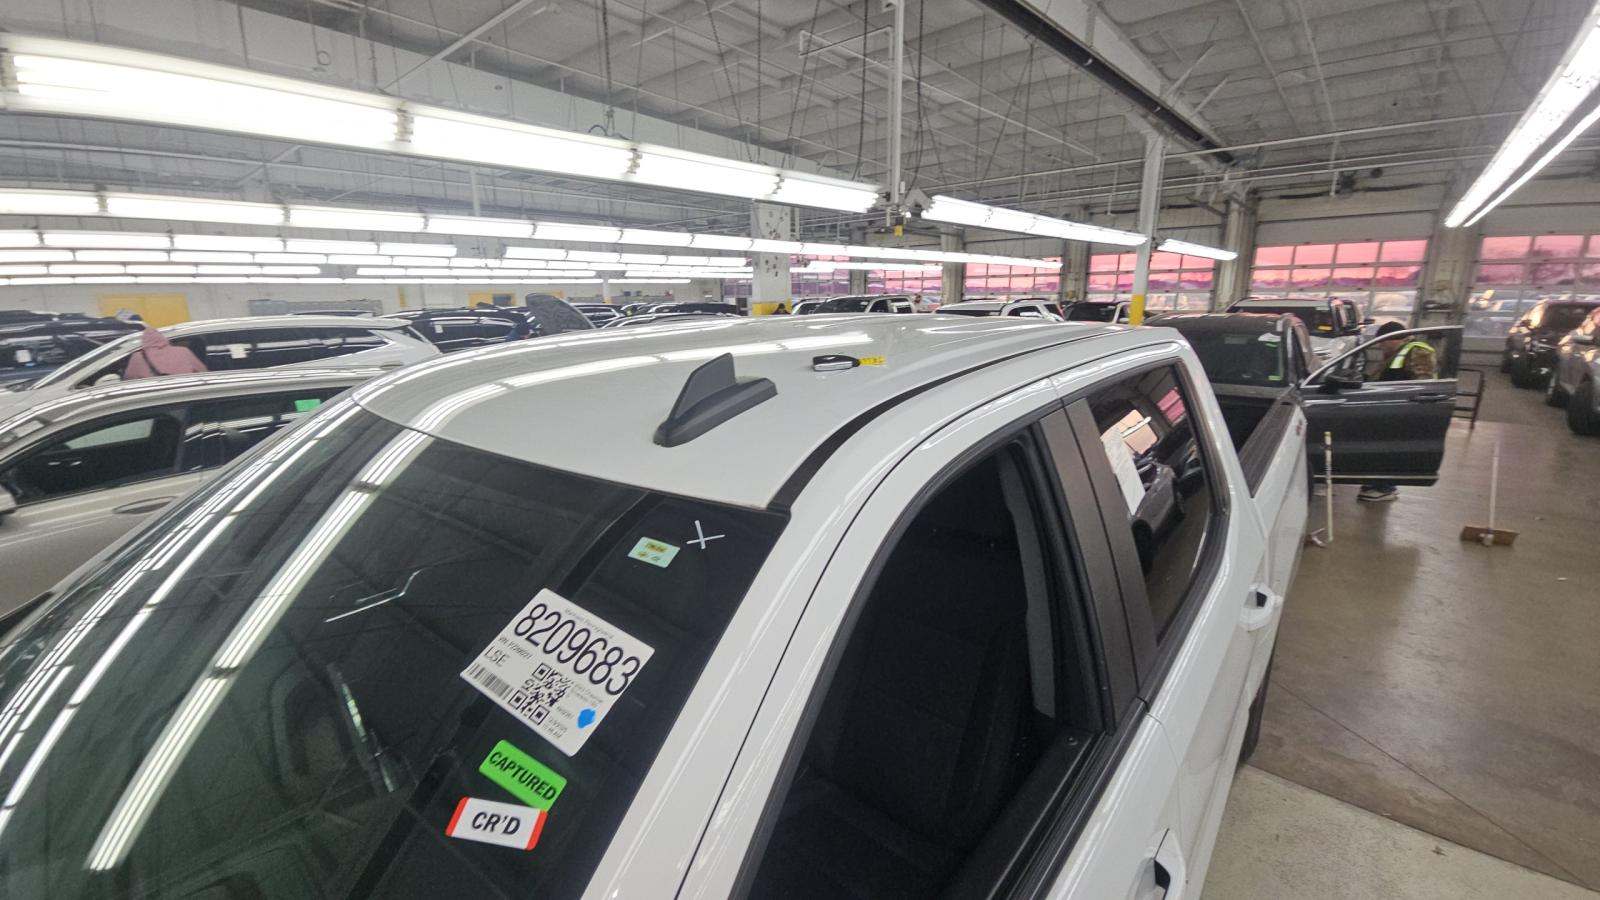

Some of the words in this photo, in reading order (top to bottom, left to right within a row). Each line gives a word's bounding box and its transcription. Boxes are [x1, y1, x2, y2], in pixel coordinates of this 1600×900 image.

[514, 603, 641, 695] 8209683
[489, 752, 556, 800] CAPTURED
[472, 812, 520, 835] CR'D
